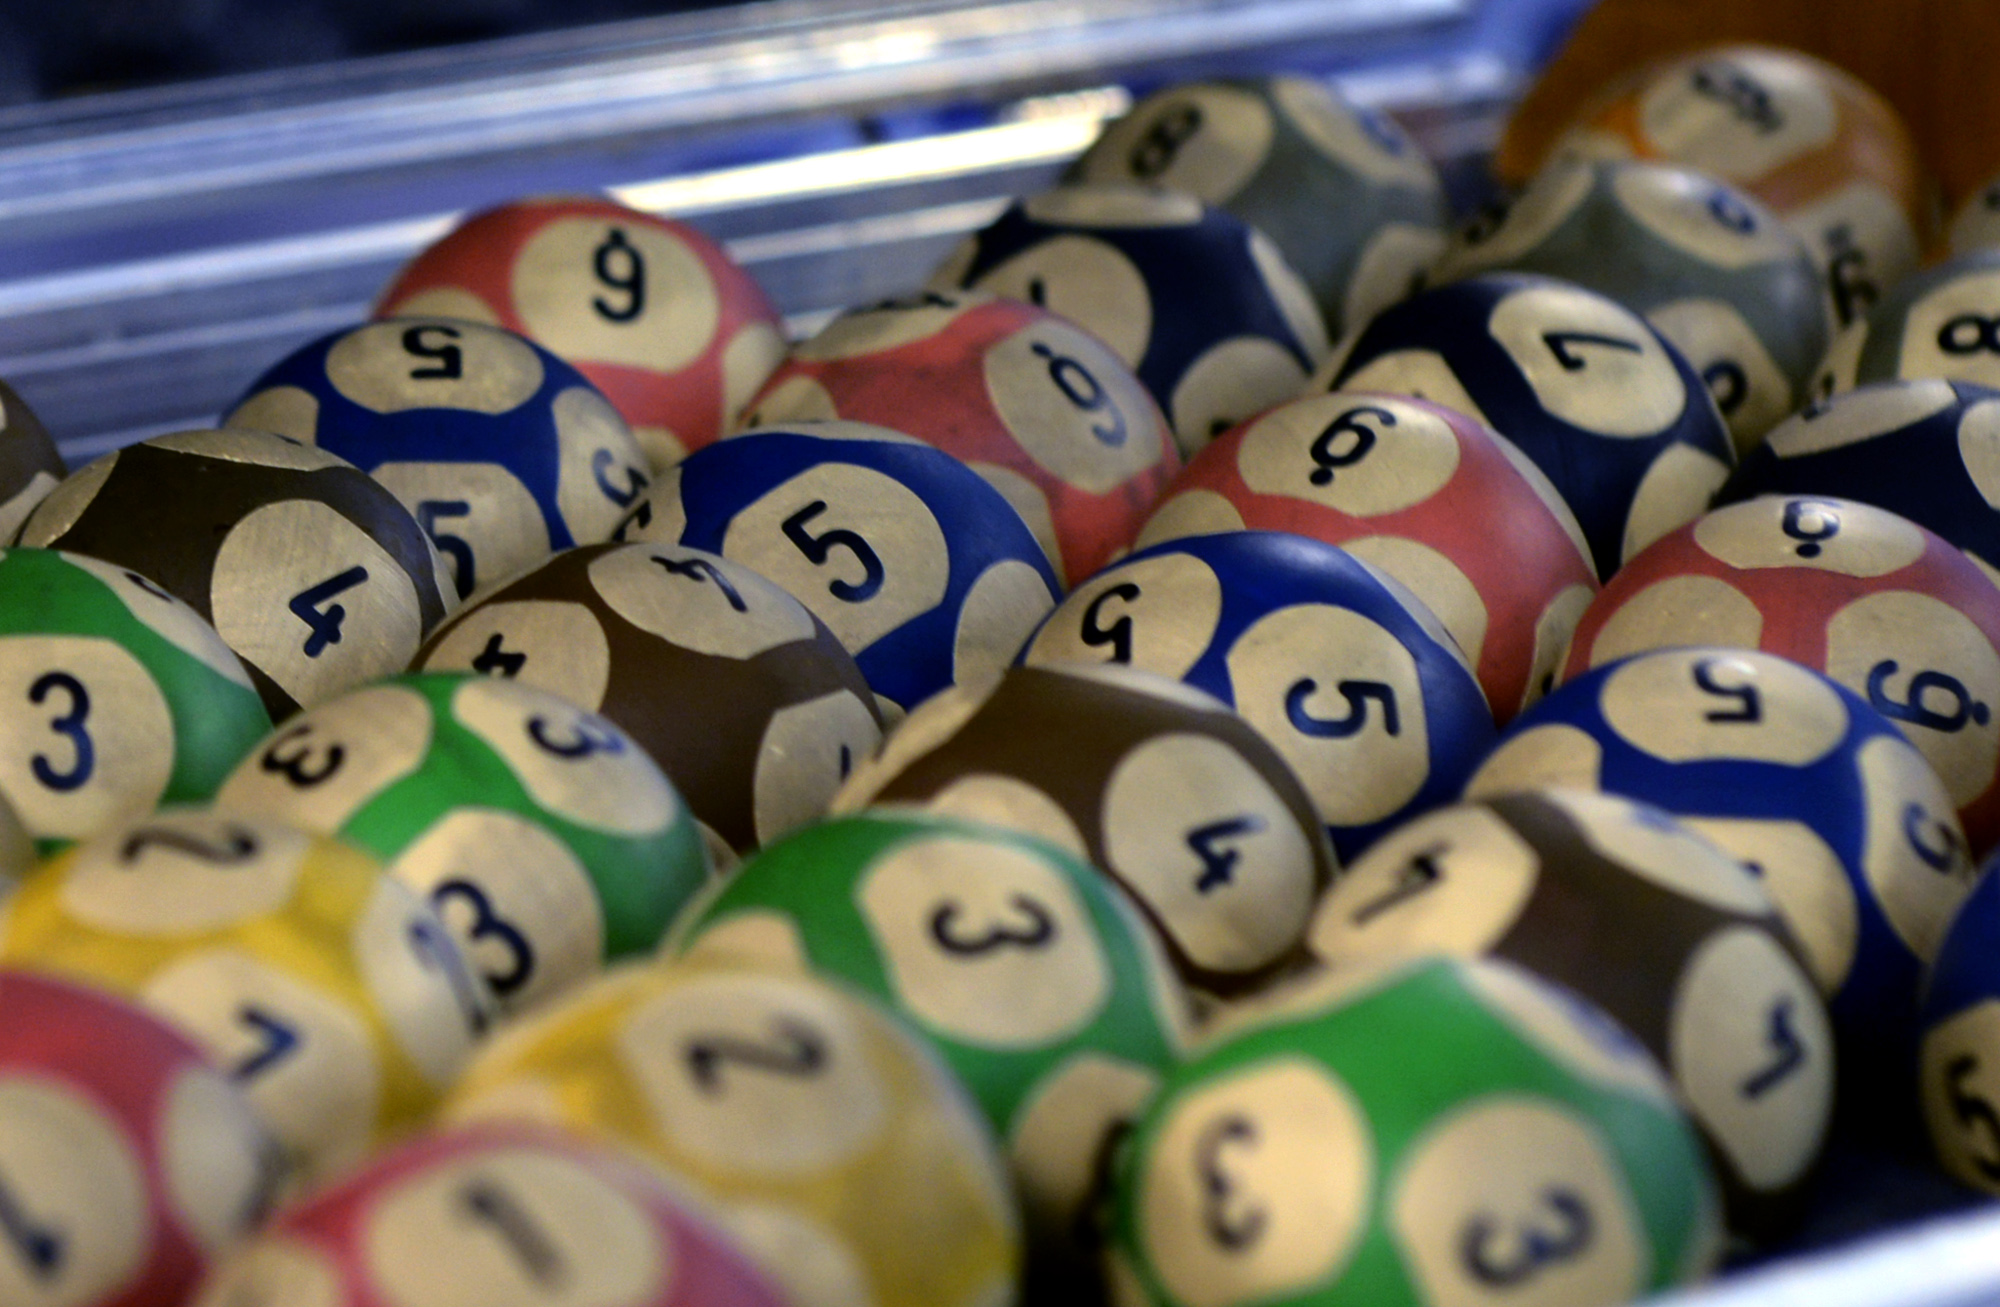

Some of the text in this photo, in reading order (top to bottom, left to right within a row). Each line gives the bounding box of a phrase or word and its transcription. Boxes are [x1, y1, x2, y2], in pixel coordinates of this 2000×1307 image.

[402, 326, 463, 380] 5
[1542, 331, 1643, 371] 7
[417, 500, 475, 600] 5
[783, 500, 885, 602] 5
[289, 565, 369, 658] 4
[28, 672, 95, 792] 3
[1286, 677, 1401, 738] 5
[1693, 657, 1763, 723] 5
[261, 728, 345, 788] 3
[1186, 814, 1268, 895] 4
[431, 878, 534, 995] 3
[930, 897, 1058, 957] 3
[1197, 1110, 1265, 1254] 3
[1456, 1184, 1595, 1289] 3
